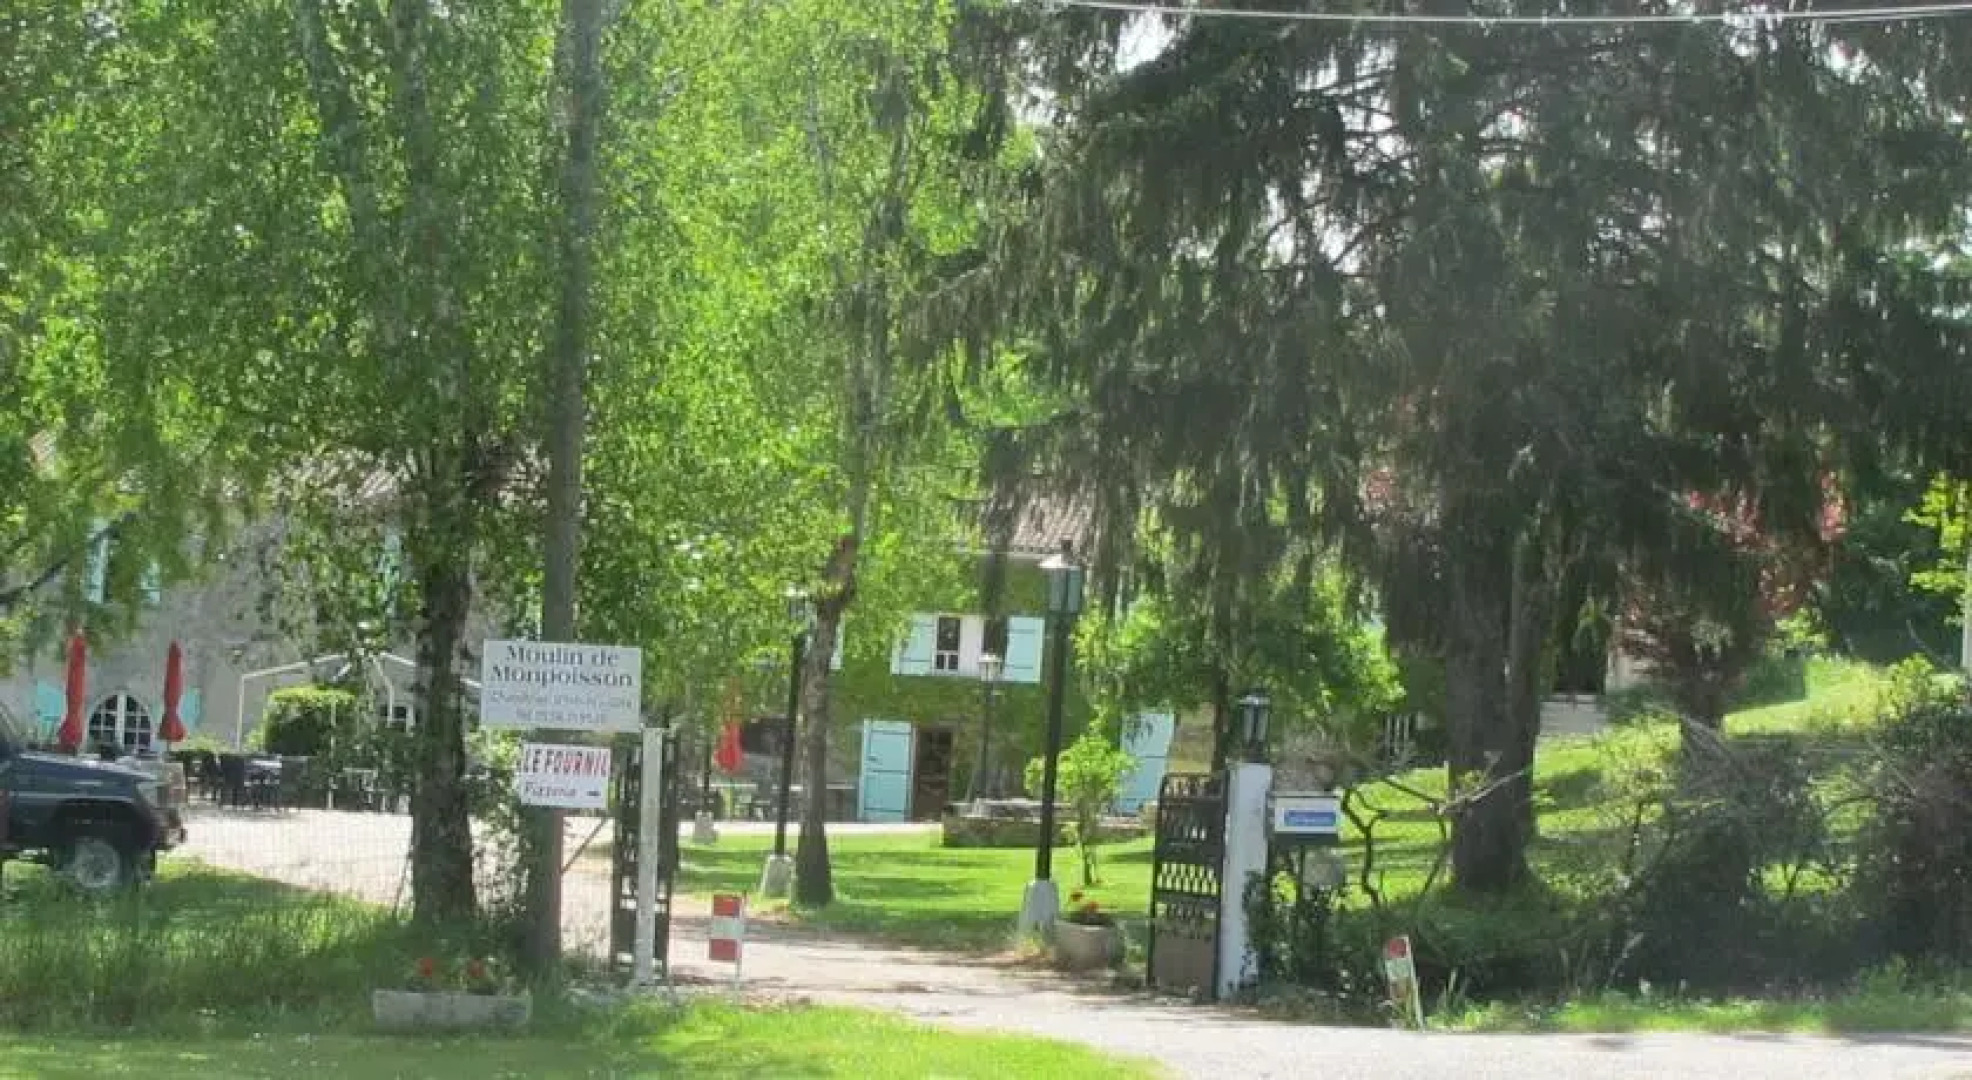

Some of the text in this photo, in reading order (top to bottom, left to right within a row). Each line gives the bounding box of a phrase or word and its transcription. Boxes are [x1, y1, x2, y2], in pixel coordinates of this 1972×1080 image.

[506, 645, 620, 667] Moulin de
[491, 665, 633, 687] Monpoisson
[522, 748, 608, 777] LE FOURNIL
